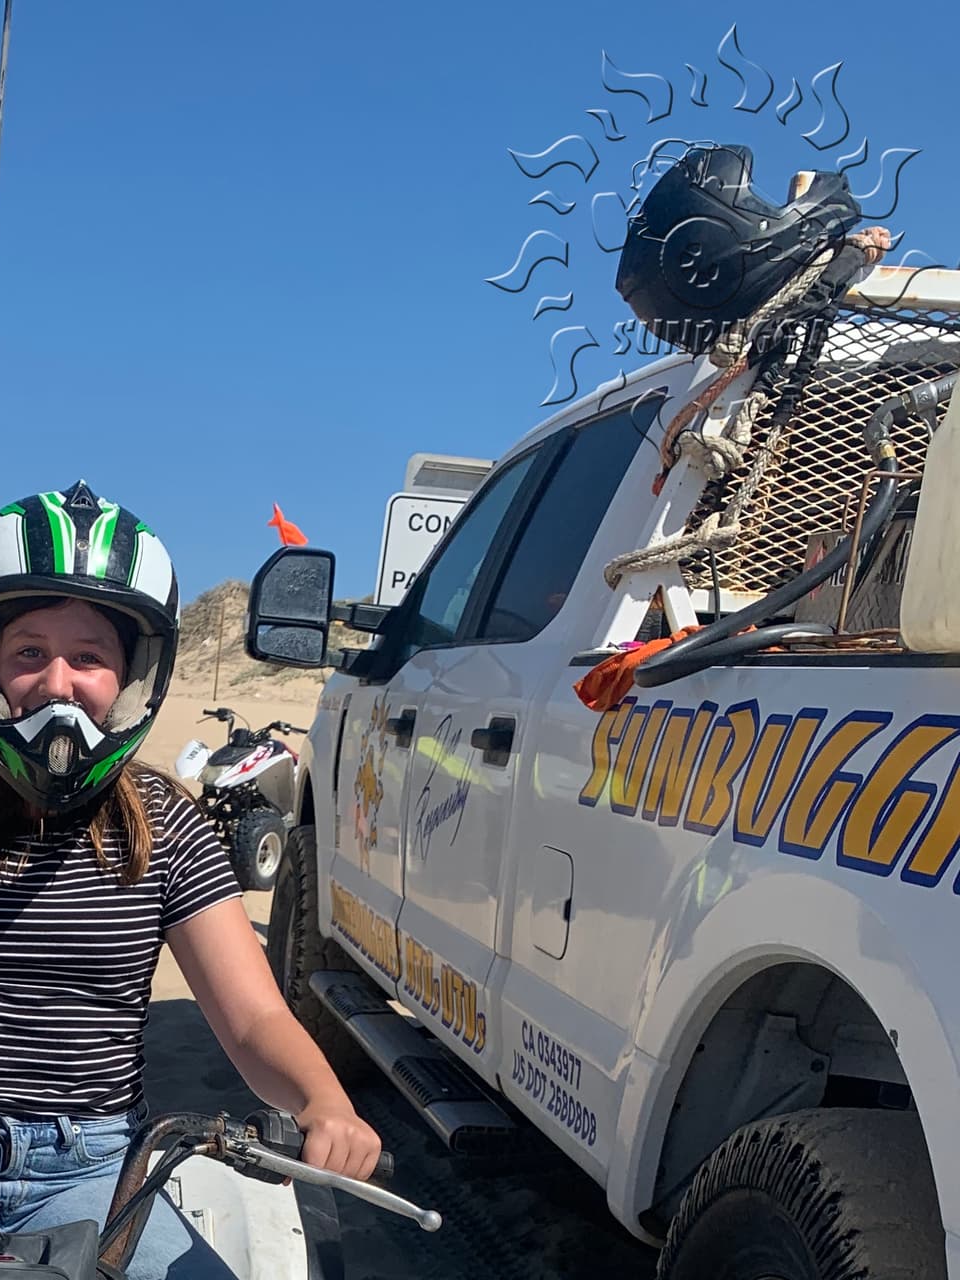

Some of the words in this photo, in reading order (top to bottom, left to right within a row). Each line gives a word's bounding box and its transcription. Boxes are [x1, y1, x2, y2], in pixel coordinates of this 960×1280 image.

[512, 1049, 526, 1085] US
[525, 1061, 548, 1104] DOT
[522, 1020, 536, 1057] CA
[537, 1031, 582, 1091] 0343977
